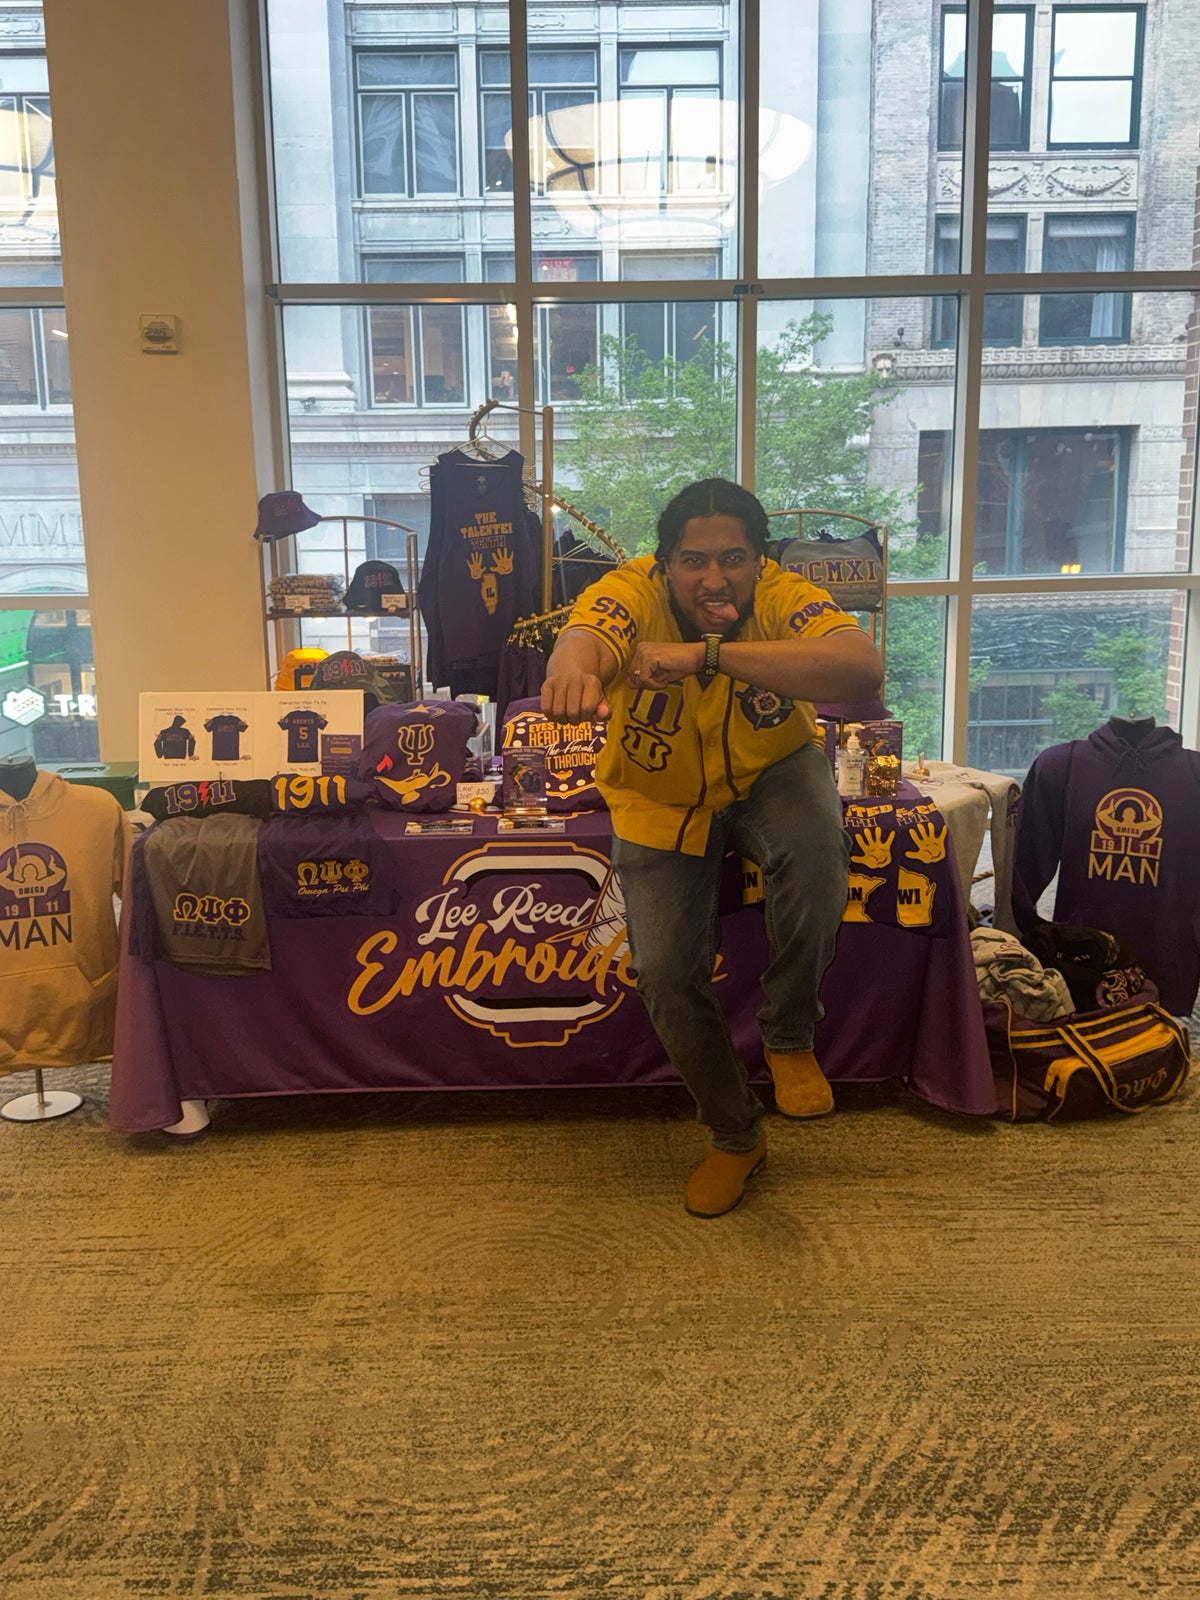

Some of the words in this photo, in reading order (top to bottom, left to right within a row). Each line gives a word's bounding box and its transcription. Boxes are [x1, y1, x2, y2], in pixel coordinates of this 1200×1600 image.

[475, 511, 497, 524] THE
[299, 726, 309, 740] 5
[529, 721, 555, 733] EYES
[529, 729, 560, 746] HEAD
[563, 728, 593, 742] HIGH
[275, 775, 347, 811] 1911
[1116, 826, 1140, 836] OMEGA
[1101, 839, 1115, 851] 19
[1139, 843, 1151, 855] 11
[297, 859, 369, 885] ΩΨΦ
[1088, 852, 1160, 888] MAN
[18, 886, 45, 896] OMEGA
[298, 886, 329, 897] Omega
[332, 885, 350, 895] Psi
[352, 882, 370, 893] Phi
[4, 904, 20, 917] 19
[46, 901, 60, 913] 11
[173, 893, 251, 926] ΩΨΦ
[414, 887, 480, 945] Lee
[487, 883, 601, 934] Reed
